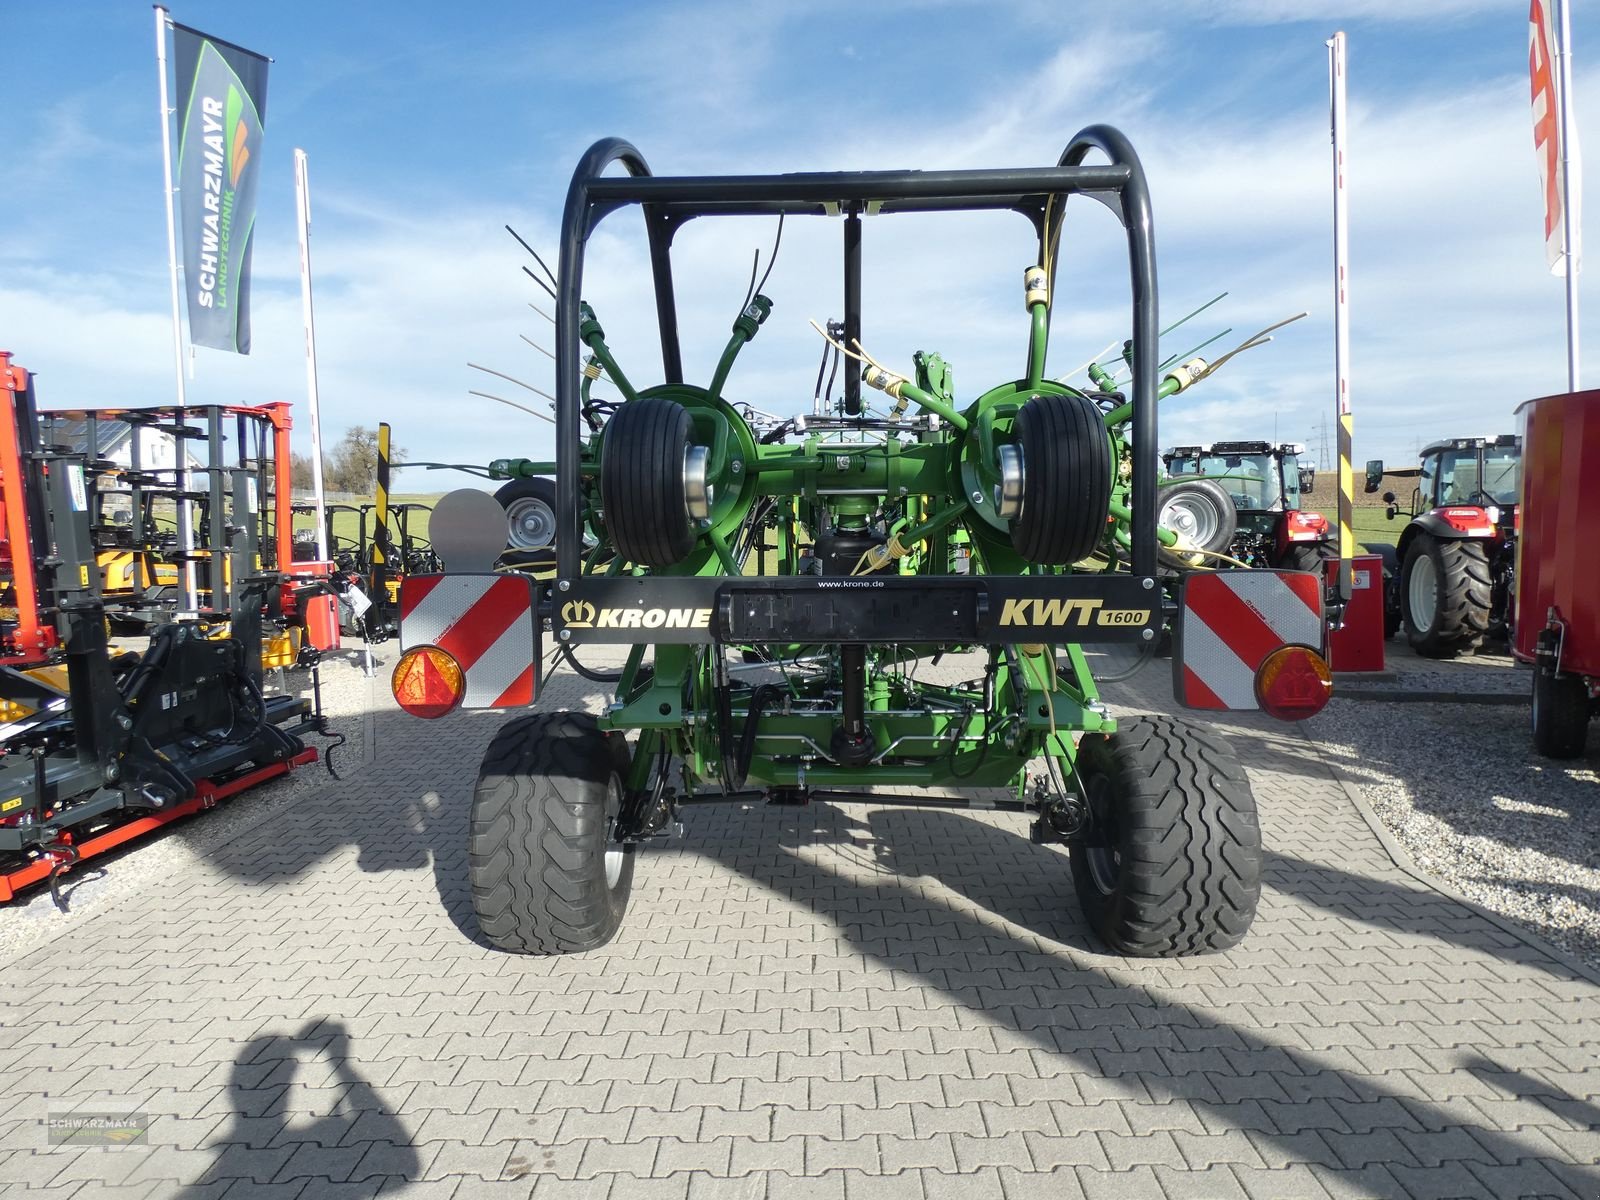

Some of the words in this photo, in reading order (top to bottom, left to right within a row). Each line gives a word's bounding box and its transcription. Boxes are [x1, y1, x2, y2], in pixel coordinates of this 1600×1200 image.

[199, 96, 224, 309] SCHWARZMAYR
[218, 190, 235, 309] LANDTECHNIK
[817, 580, 885, 588] www.krone.de
[597, 608, 713, 628] KRONE
[999, 599, 1104, 626] KWT
[1105, 612, 1142, 624] 1600
